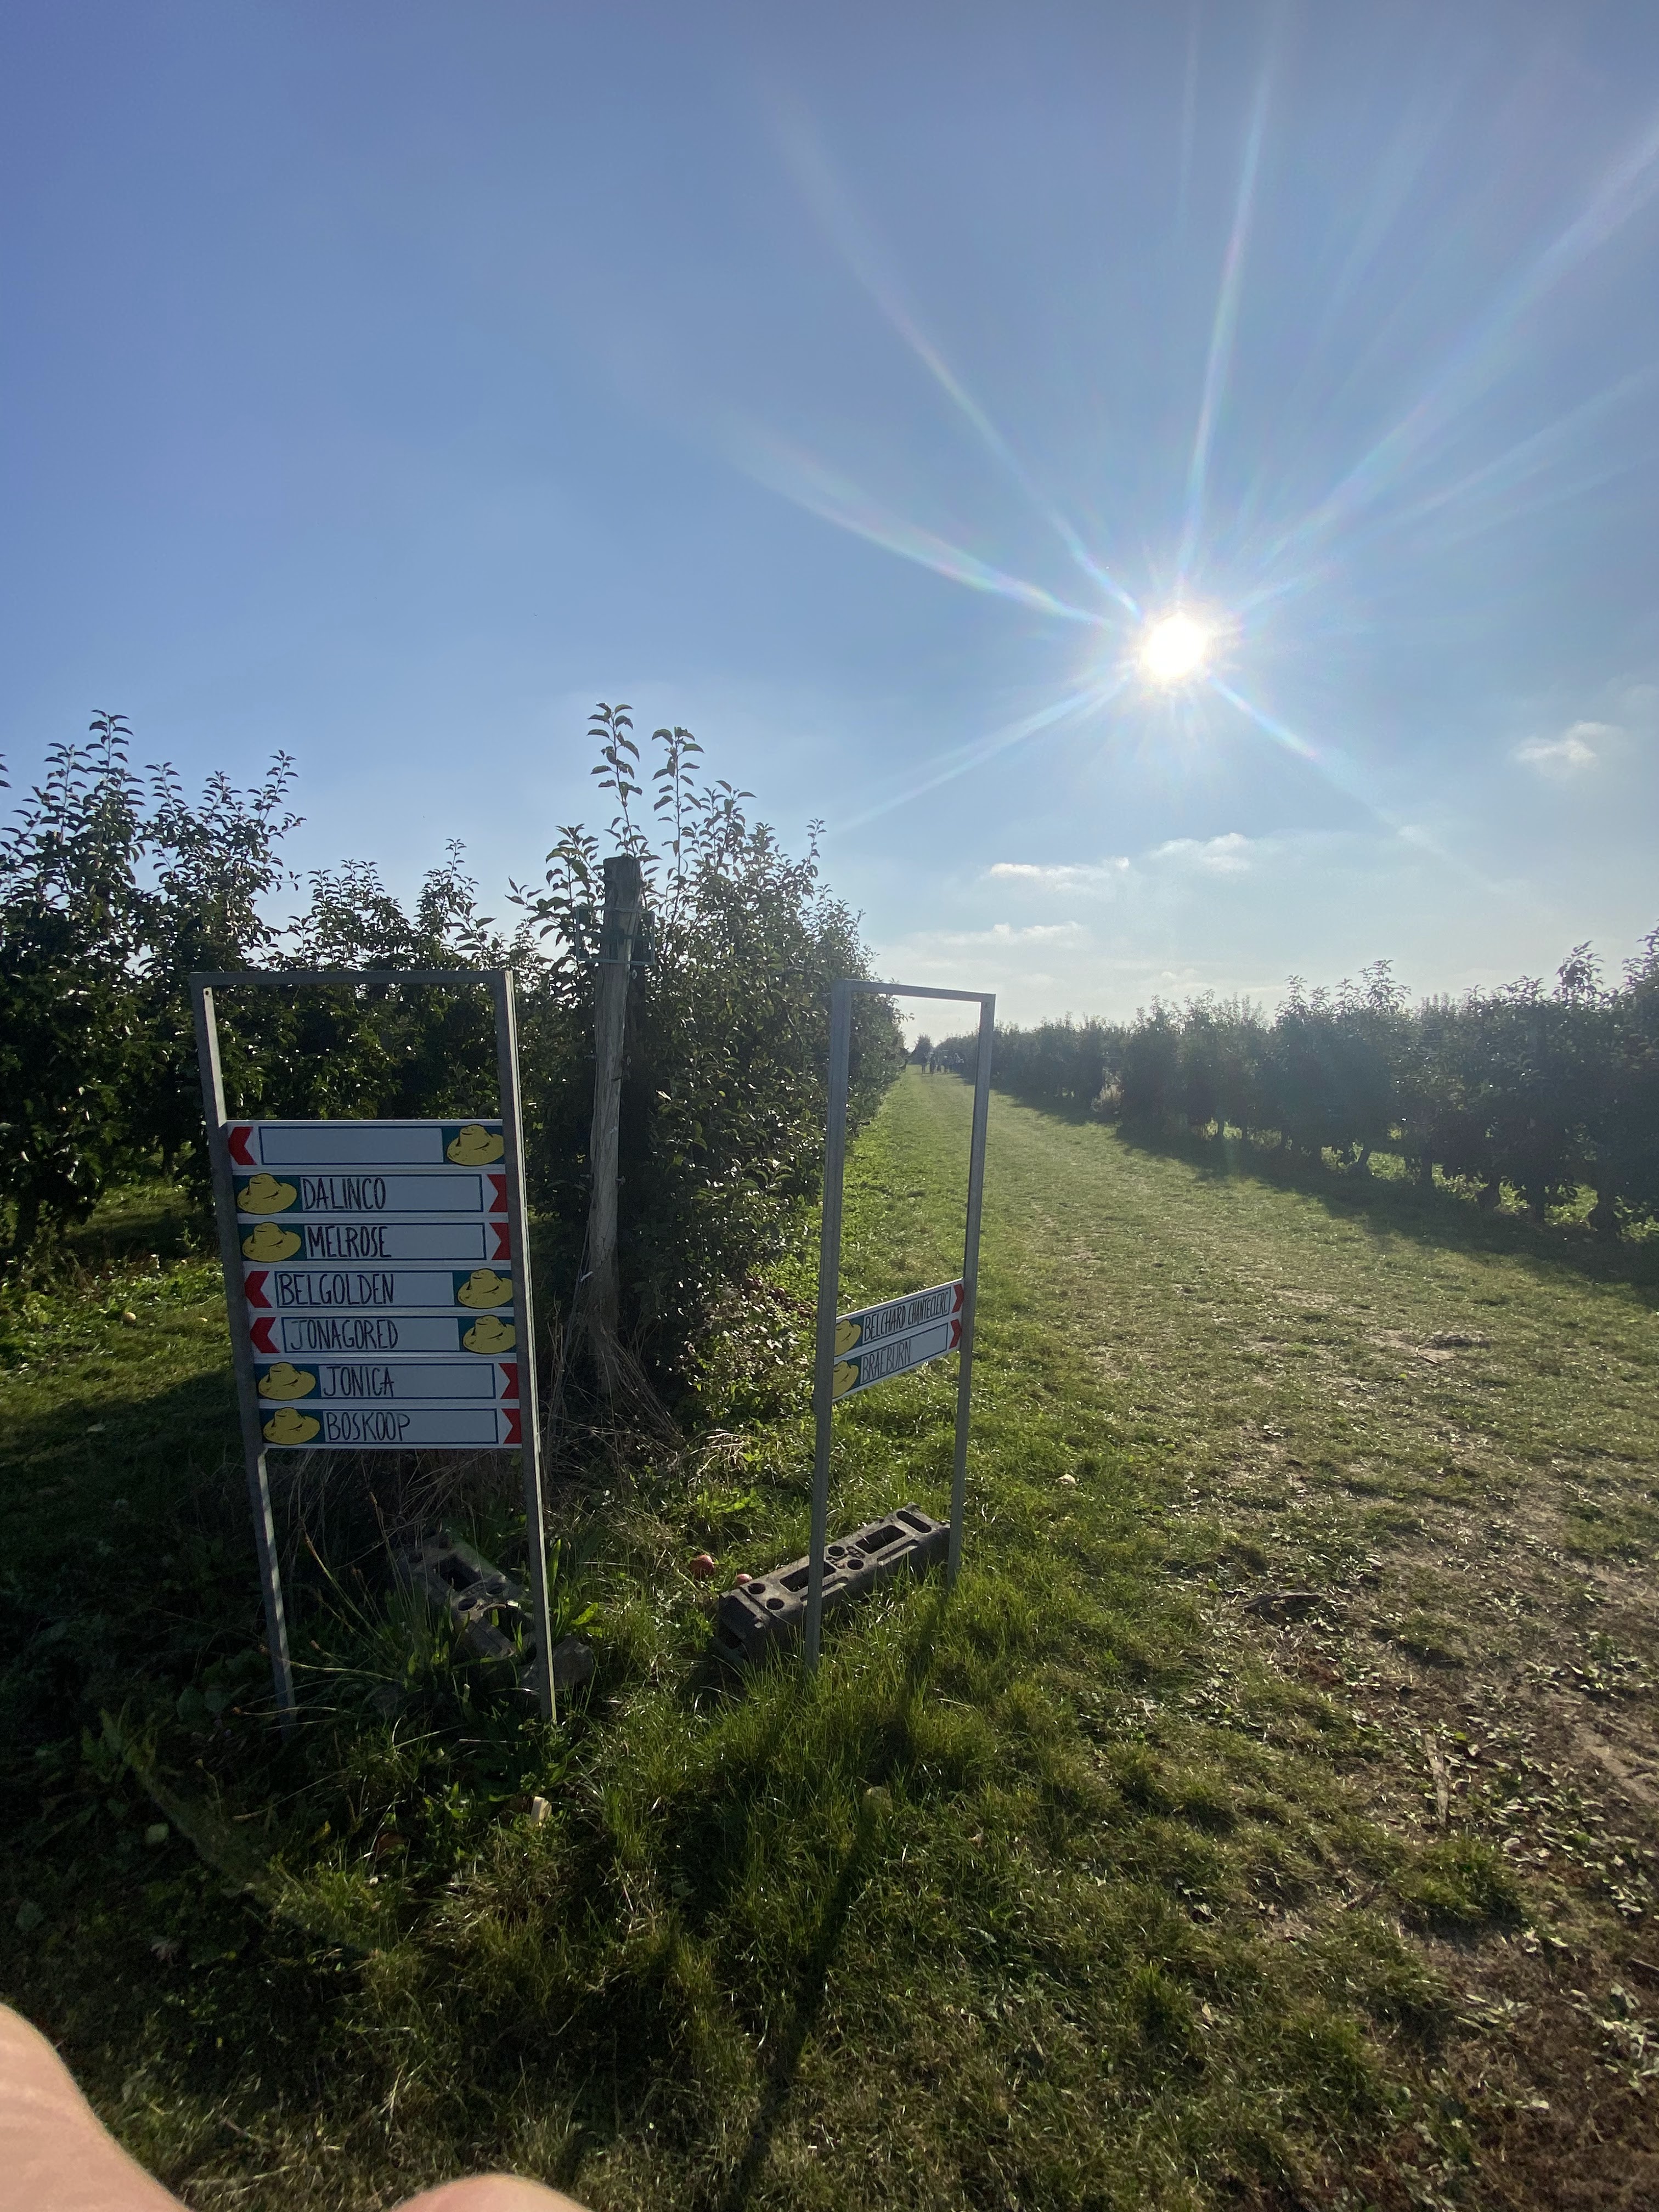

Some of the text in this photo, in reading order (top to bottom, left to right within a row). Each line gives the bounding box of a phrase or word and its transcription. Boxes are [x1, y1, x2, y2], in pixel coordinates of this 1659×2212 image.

[302, 1177, 386, 1210] DALINCO
[308, 1226, 392, 1258] MELROSE
[280, 1273, 393, 1305] BELGOLDEN
[864, 1292, 948, 1340] BELCHARD CHANTECLERC
[290, 1319, 398, 1350] JONAGORED
[862, 1340, 911, 1381] BRAEBURN
[323, 1367, 394, 1397] JONICA
[327, 1412, 410, 1441] BOSKOOP
